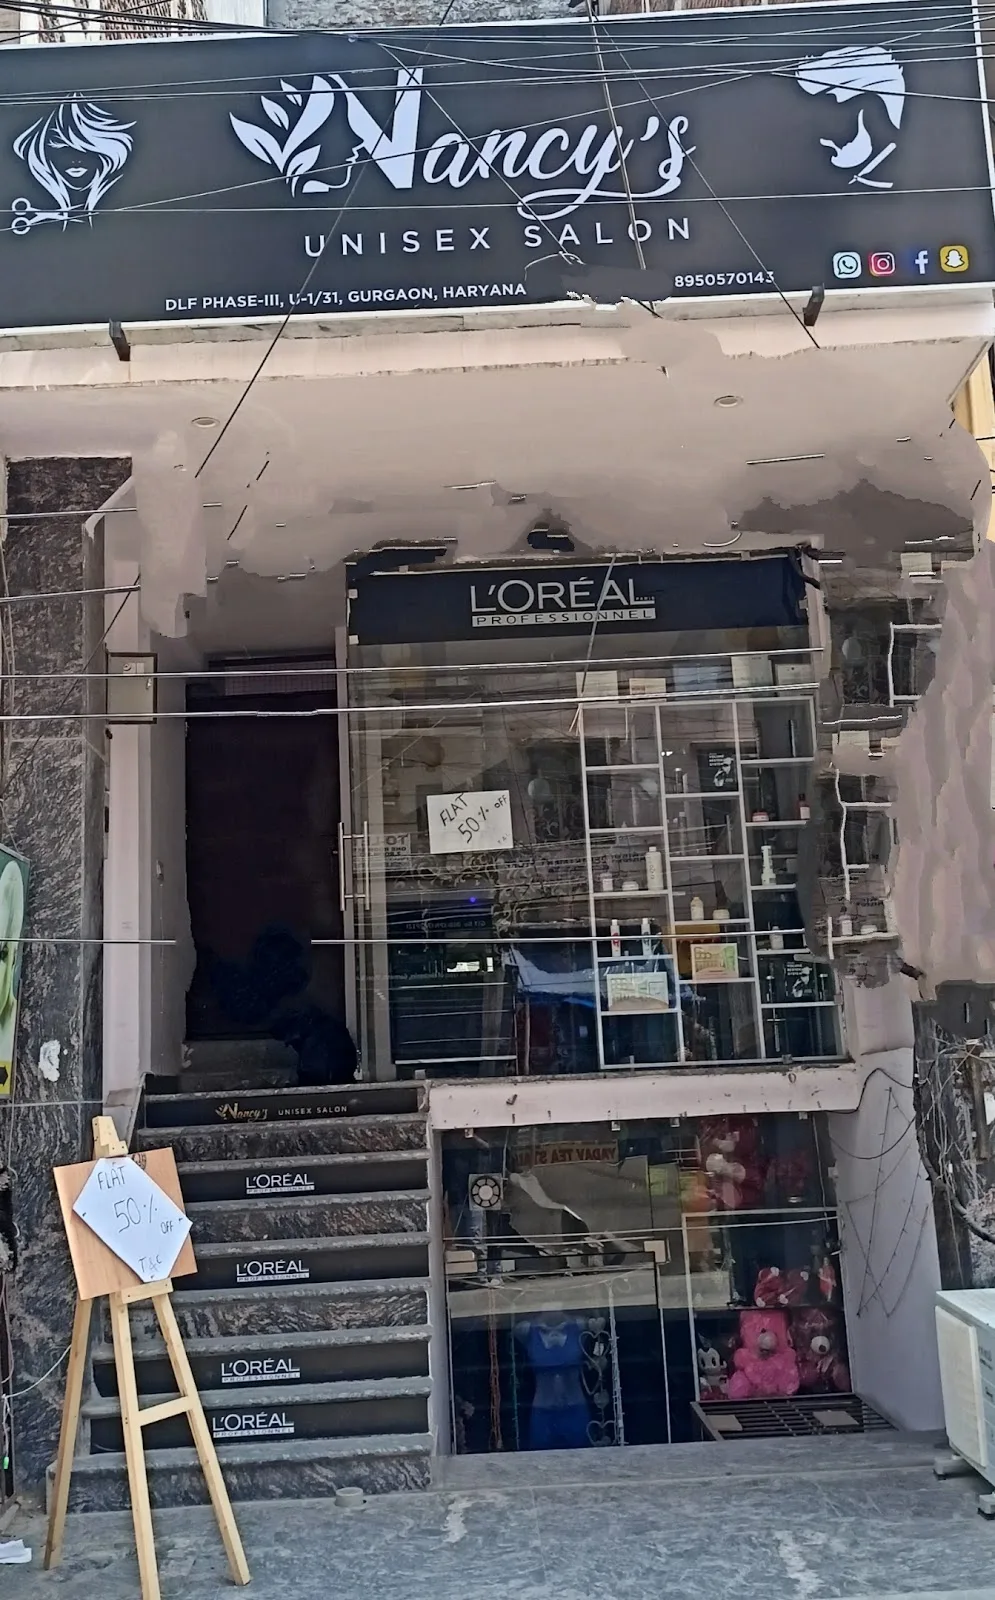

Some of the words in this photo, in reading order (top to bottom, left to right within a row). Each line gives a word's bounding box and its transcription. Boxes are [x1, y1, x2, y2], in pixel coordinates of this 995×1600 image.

[230, 66, 696, 220] Nancy's
[304, 228, 491, 257] UNISEX
[523, 218, 690, 248] SALON
[674, 271, 775, 288] 8950570143
[165, 298, 197, 311] DLF
[202, 294, 284, 309] PHASE-III,
[347, 287, 438, 303] GURGAON,
[443, 283, 527, 299] HARYANA
[470, 576, 655, 613] L'ORÉAL
[475, 610, 654, 626] PROFESSIONNEL
[439, 792, 468, 827] FLAT
[215, 1102, 268, 1122] Nancy's
[278, 1107, 312, 1116] UNISEX
[316, 1105, 347, 1114] SALON
[98, 1165, 126, 1190] FLAT
[246, 1172, 315, 1188] L'ORÉAL
[113, 1193, 158, 1233] 50%
[160, 1220, 174, 1235] OFF
[236, 1259, 310, 1276] L'ORÉAL
[221, 1357, 301, 1376] L'ORÉAL
[212, 1411, 295, 1431] L'ORÉAL
